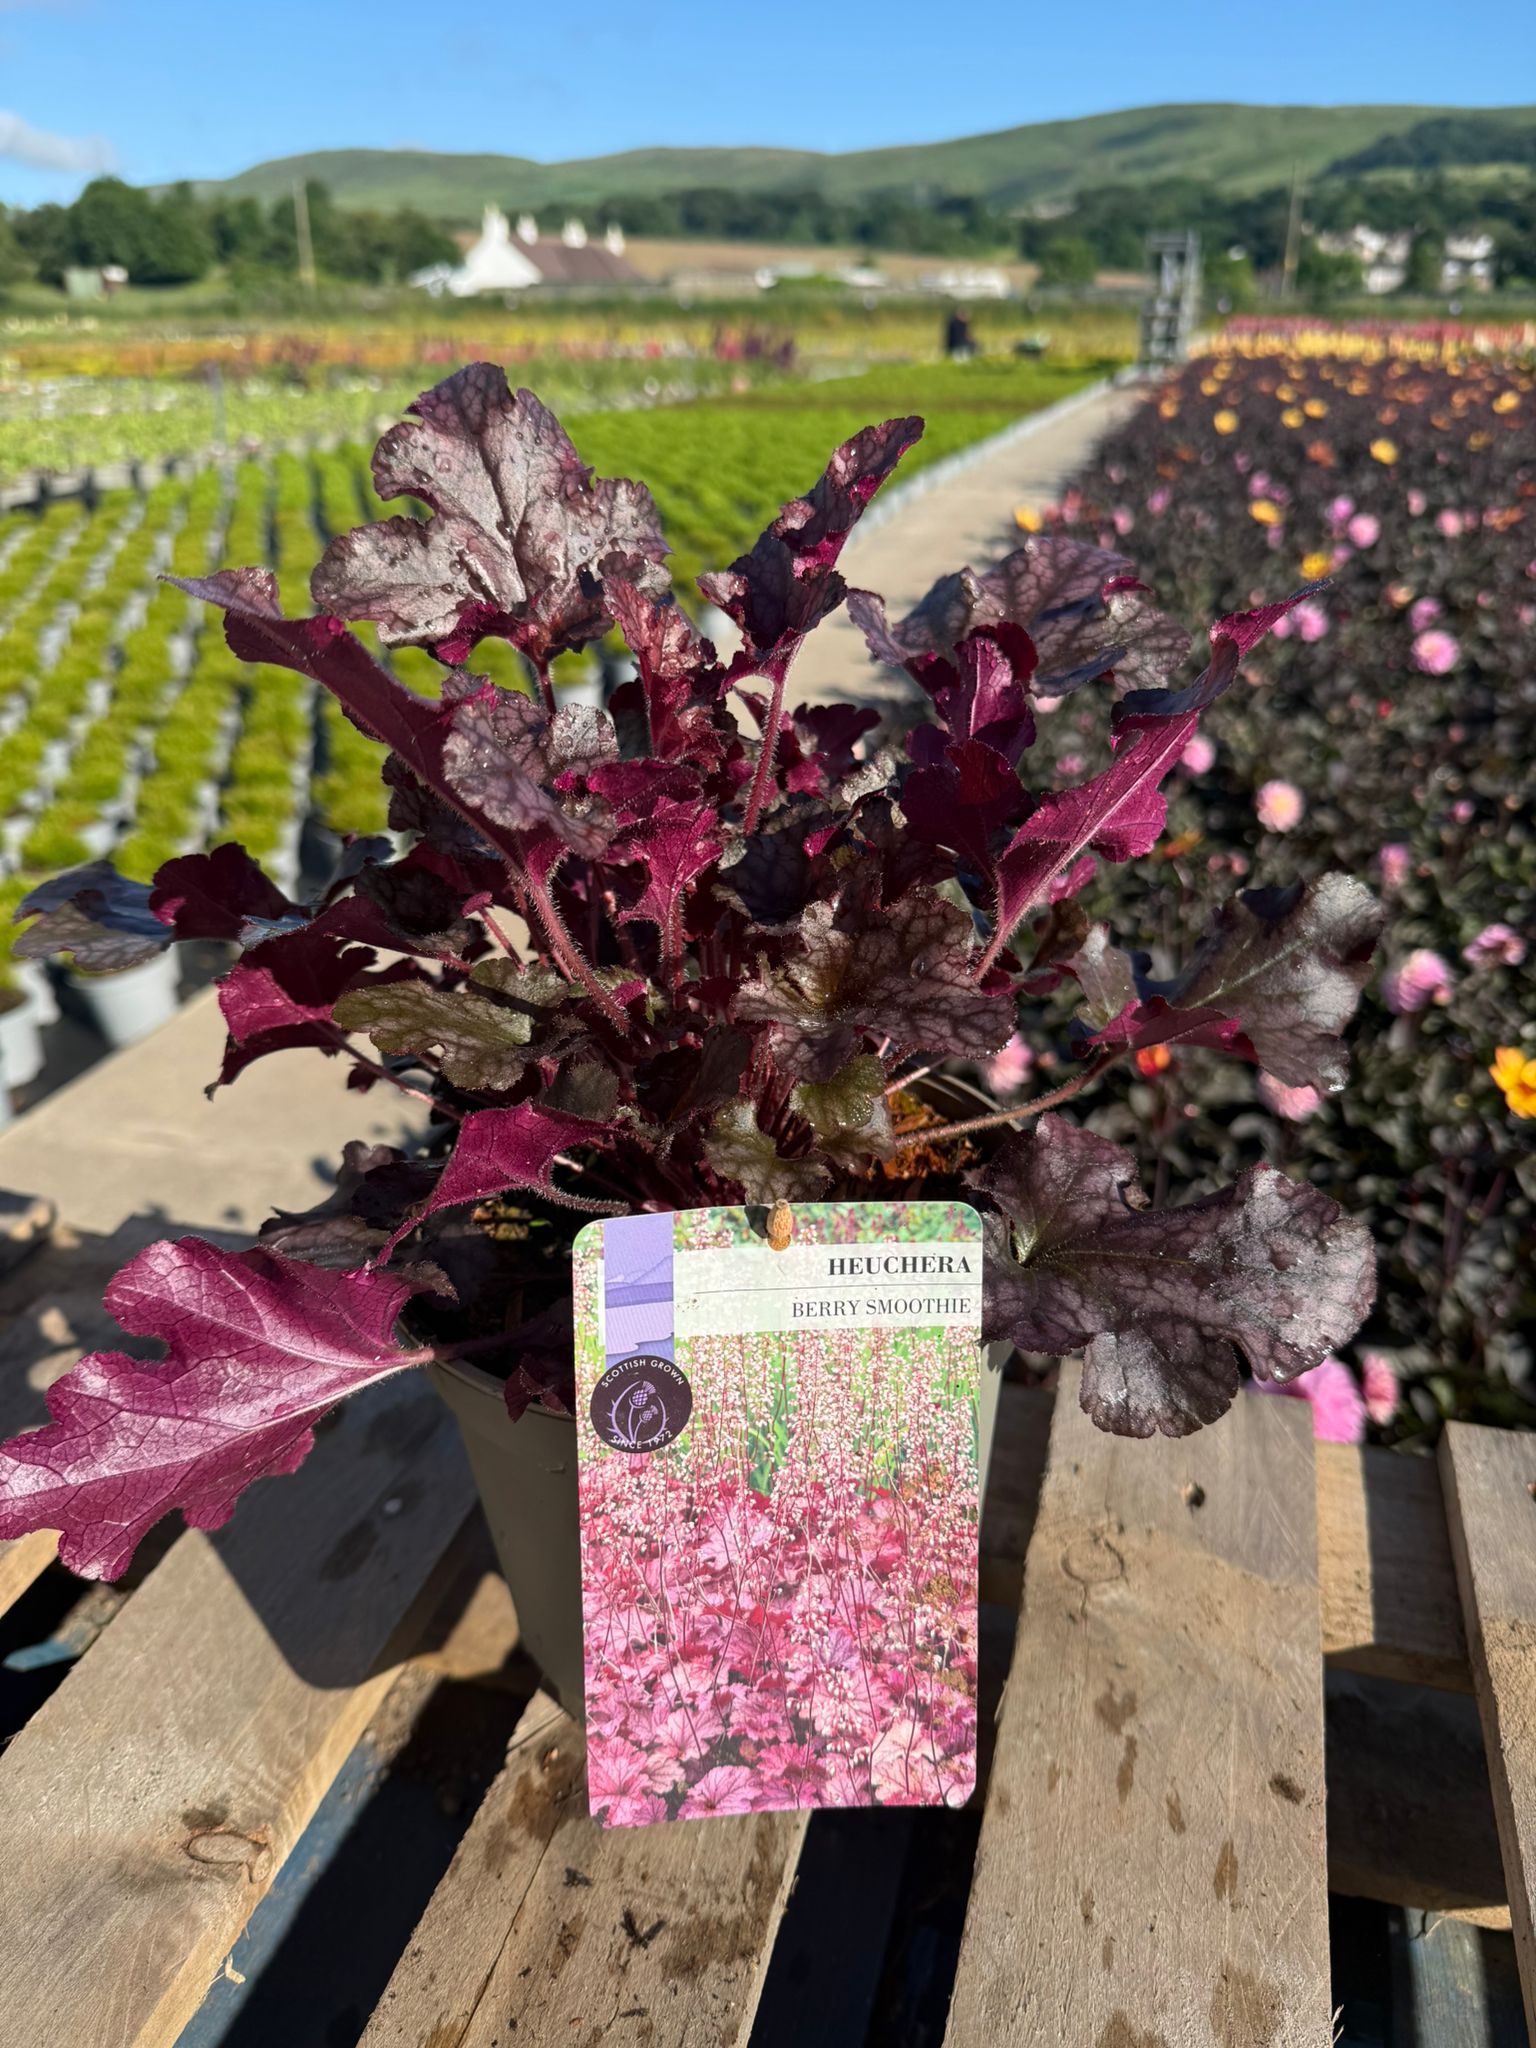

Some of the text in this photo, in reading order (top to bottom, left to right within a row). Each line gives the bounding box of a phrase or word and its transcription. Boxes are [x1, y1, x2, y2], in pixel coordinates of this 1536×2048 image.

[827, 1255, 972, 1276] HEUCHERA
[792, 1298, 972, 1318] BERRY SMOOTHIE
[601, 1359, 685, 1388] SCOTTISH GROWN
[610, 1430, 673, 1449] SINCE 1972
